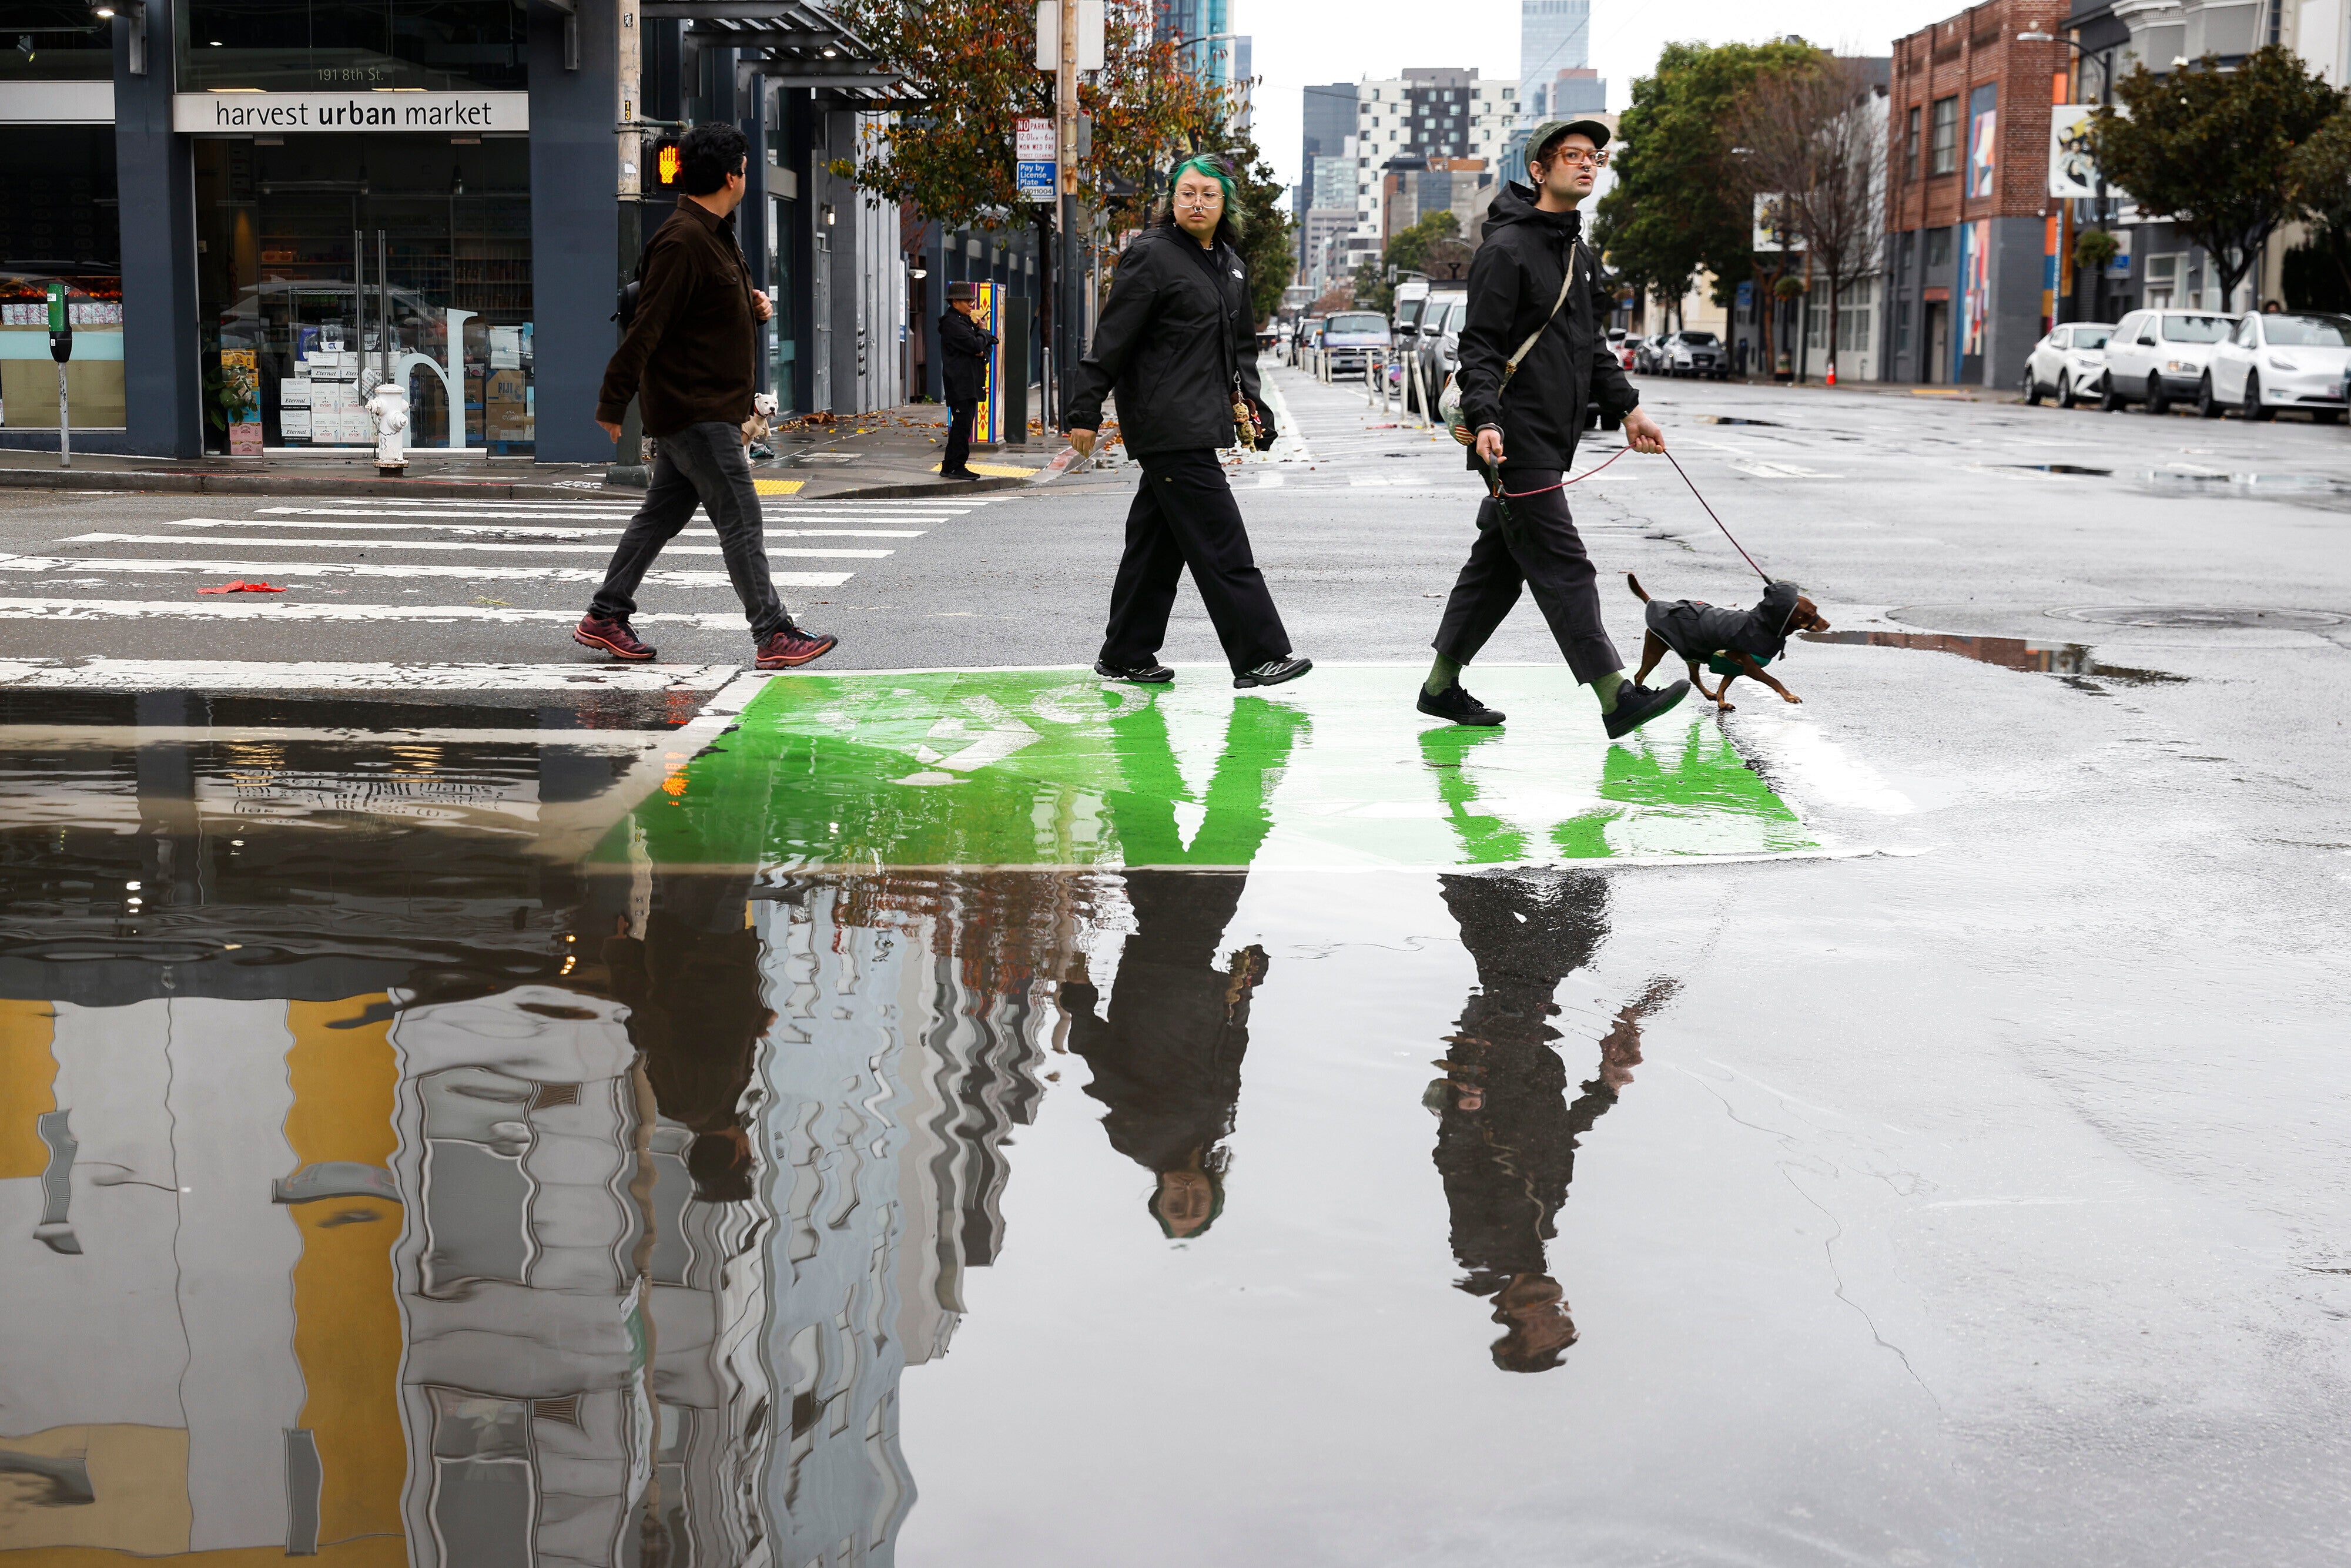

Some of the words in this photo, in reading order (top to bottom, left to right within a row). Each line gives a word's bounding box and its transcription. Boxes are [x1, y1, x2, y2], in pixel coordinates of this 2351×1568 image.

[318, 68, 338, 81] 191
[342, 68, 363, 81] 8th
[368, 68, 384, 81] St.
[216, 100, 309, 125] harvest
[319, 99, 396, 125] urban
[406, 99, 492, 125] market
[1018, 120, 1029, 131] NO
[1020, 164, 1034, 173] Pay
[1035, 164, 1045, 173] by
[498, 382, 513, 394] FIJI
